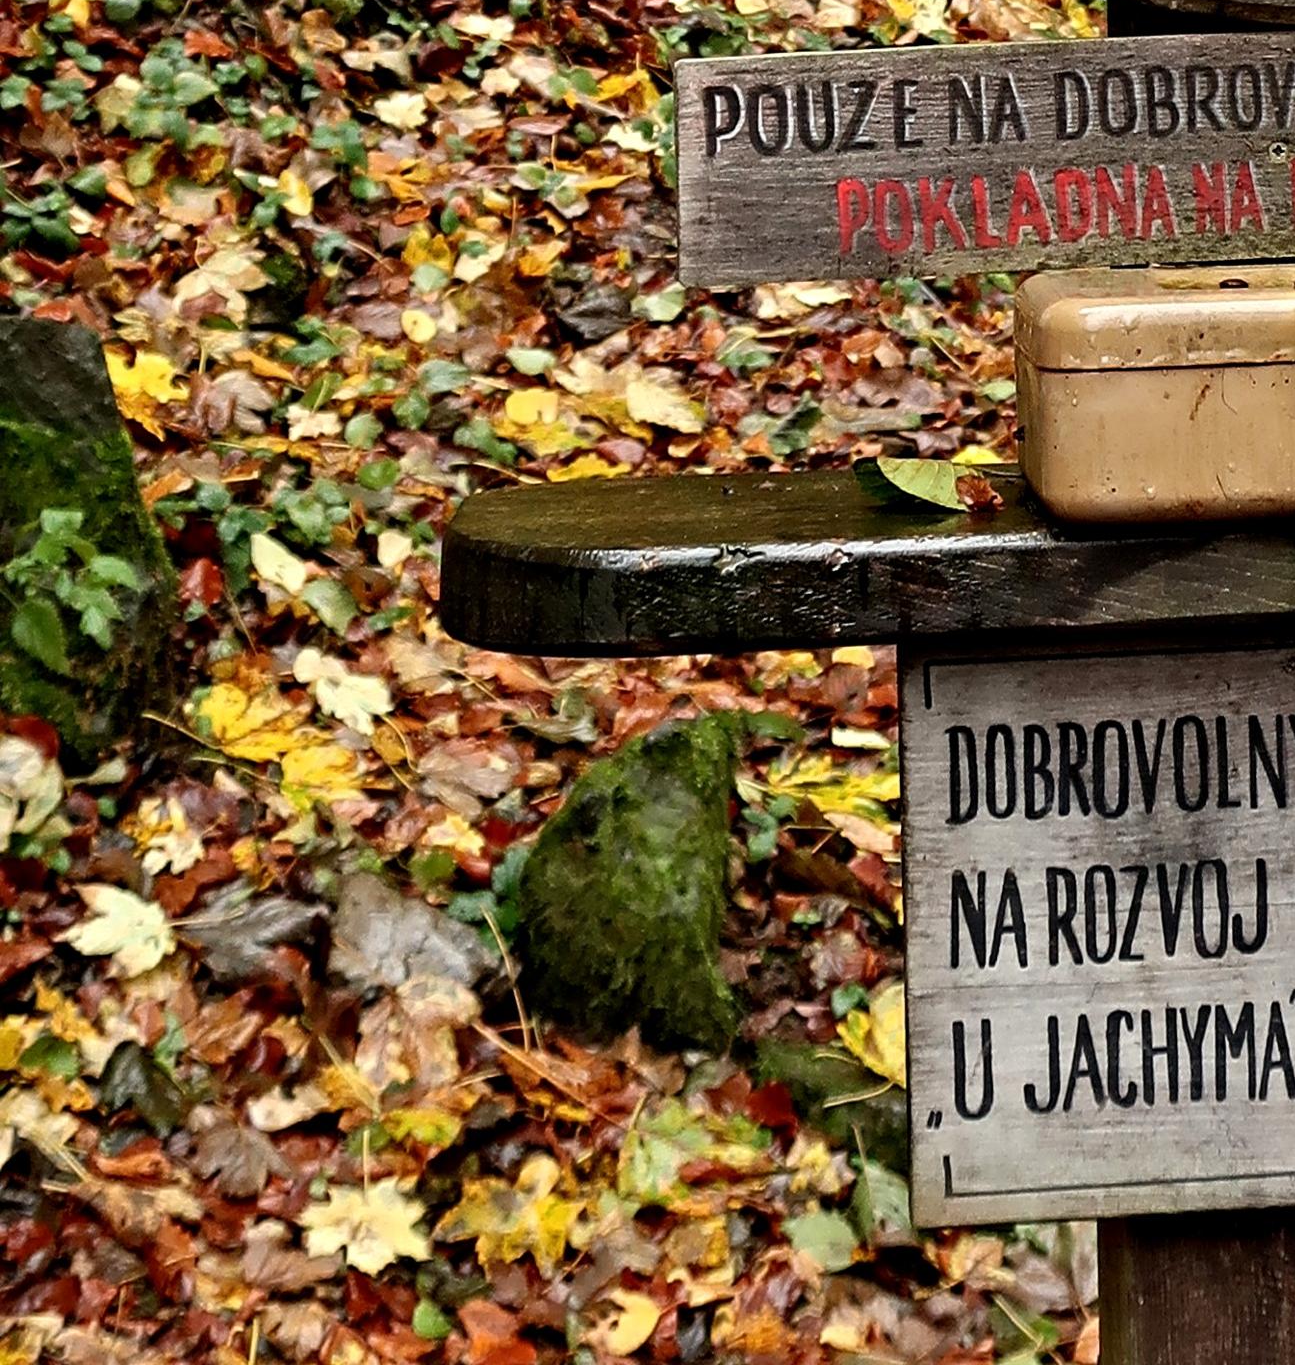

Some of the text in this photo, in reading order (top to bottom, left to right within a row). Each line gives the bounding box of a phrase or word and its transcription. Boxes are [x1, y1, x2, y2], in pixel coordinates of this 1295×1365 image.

[702, 78, 923, 158] POUZE
[948, 72, 1028, 145] NA
[836, 161, 1177, 255] POKLADNA
[1191, 160, 1267, 235] NA
[950, 868, 1029, 969] NA
[1046, 857, 1269, 966] ROZVOJ
